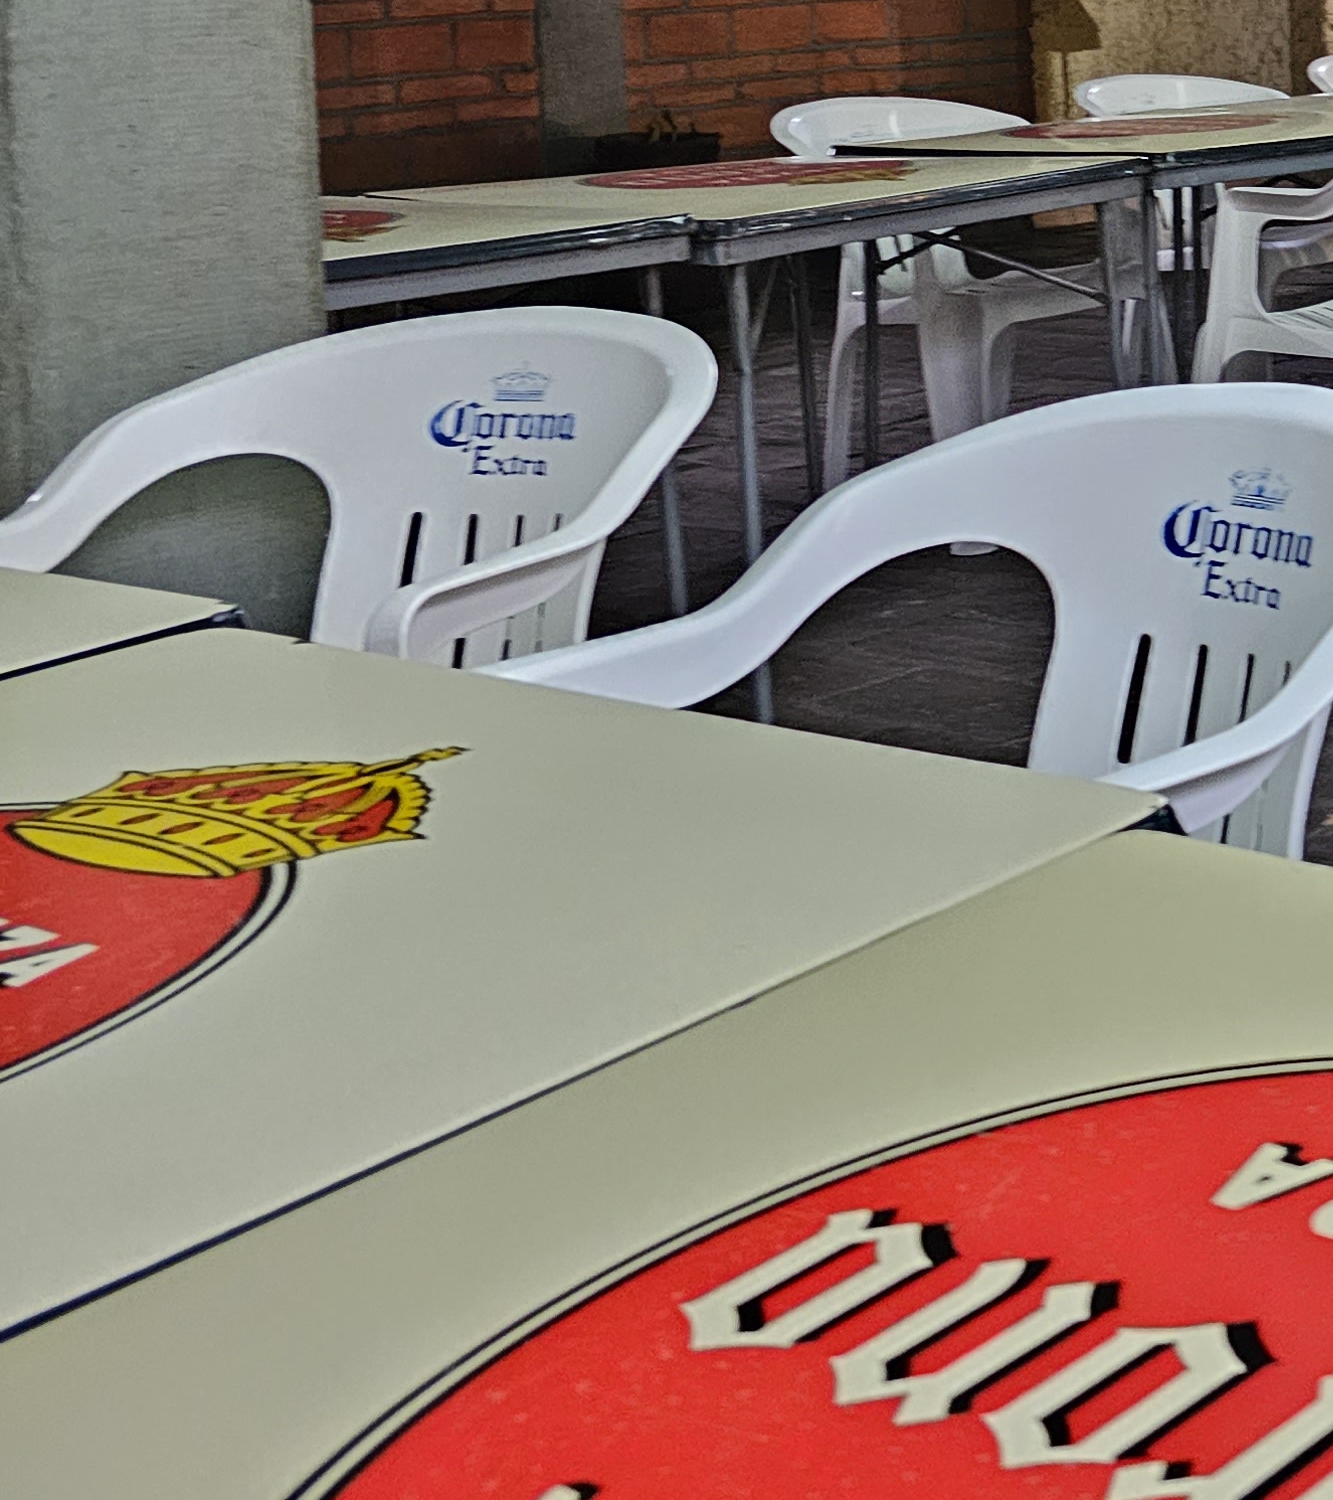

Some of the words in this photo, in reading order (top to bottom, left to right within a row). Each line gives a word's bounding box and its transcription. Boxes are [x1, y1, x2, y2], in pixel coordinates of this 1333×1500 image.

[428, 400, 576, 452] Corona
[467, 445, 548, 476] Extra
[1163, 501, 1312, 568] Corona
[1200, 560, 1281, 611] Extra
